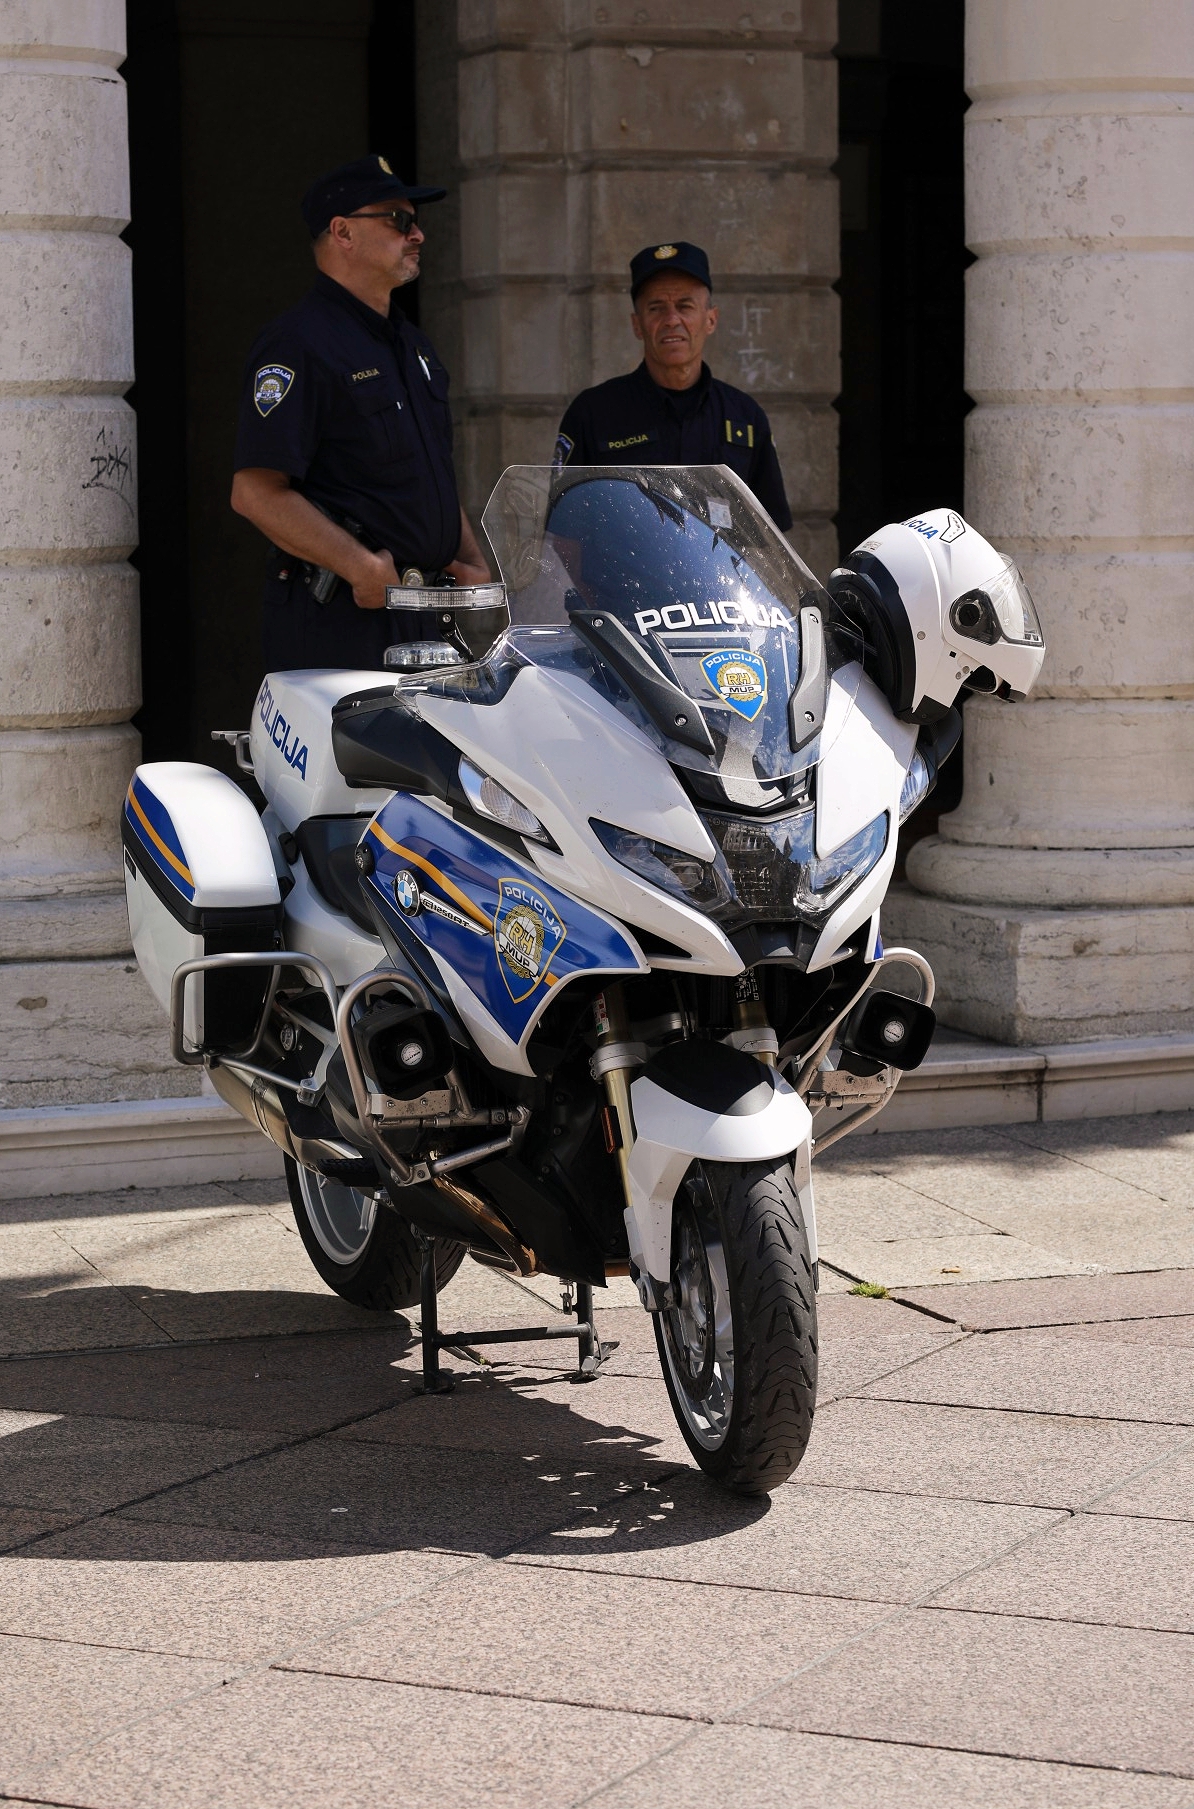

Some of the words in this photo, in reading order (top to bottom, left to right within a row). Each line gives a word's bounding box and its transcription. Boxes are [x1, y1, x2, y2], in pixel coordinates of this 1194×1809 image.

[257, 367, 292, 381] POLICIJA
[608, 433, 649, 449] POLICIJA
[633, 600, 794, 636] POLICIJA
[705, 653, 761, 669] POLICIJA
[726, 672, 751, 686] RH
[728, 685, 755, 694] MUP
[257, 679, 308, 781] POLICIJA
[504, 885, 561, 940] POLICIJA
[509, 921, 535, 956] RH
[505, 942, 531, 968] MUP
